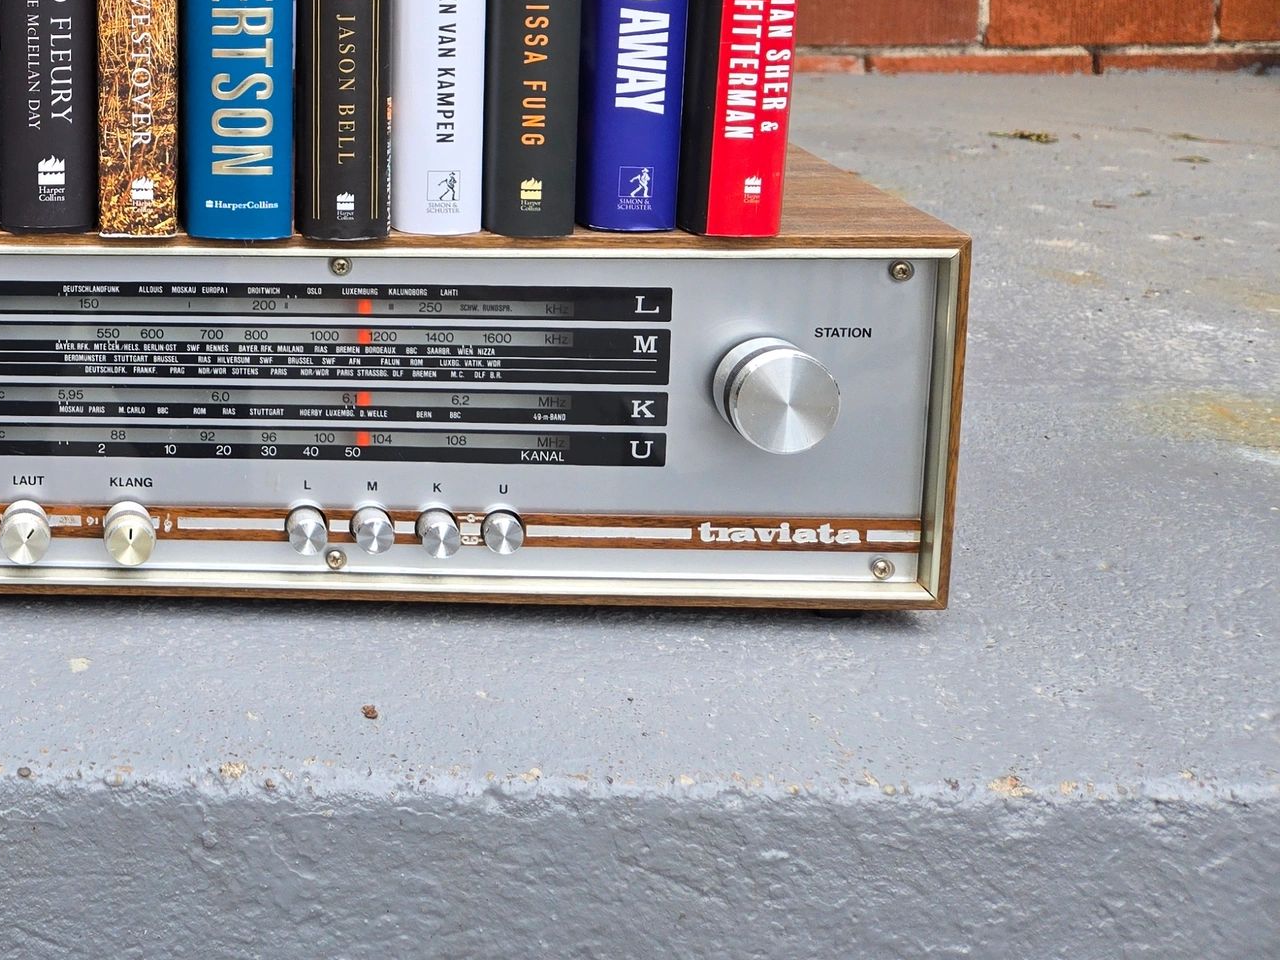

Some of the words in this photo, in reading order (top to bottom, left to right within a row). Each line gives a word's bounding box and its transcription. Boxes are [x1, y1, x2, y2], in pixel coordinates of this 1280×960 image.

[437, 23, 456, 58] VAN
[27, 14, 40, 92] McLELLAN
[336, 13, 356, 92] JASON
[615, 7, 671, 115] AWAY
[50, 17, 73, 124] FLEURY
[724, 0, 764, 139] FITTERMAN
[762, 49, 791, 111] SHER
[28, 99, 41, 130] DAY
[435, 67, 456, 144] KAMPEN
[520, 80, 547, 146] FUNG
[337, 104, 356, 165] BELL
[761, 121, 778, 132] &
[38, 185, 66, 196] Harper
[38, 193, 66, 202] Collins
[214, 200, 279, 211] HarperCollins
[247, 287, 281, 295] DROITWICH
[79, 299, 99, 309] 150
[252, 300, 276, 310] 200
[419, 302, 443, 312] 250
[634, 295, 660, 313] L
[96, 328, 120, 338] 550
[140, 329, 164, 339] 600
[200, 329, 224, 340] 700
[244, 330, 268, 340] 800
[310, 331, 339, 341] 1000
[369, 331, 397, 342] 1200
[425, 332, 454, 343] 1400
[483, 333, 512, 343] 1600
[813, 327, 873, 339] STATION
[632, 335, 658, 353] M
[114, 355, 149, 363] STUTTGART
[380, 358, 400, 366] FALUN
[58, 389, 84, 401] 5,95
[451, 395, 470, 406] 6,2
[538, 396, 566, 407] MHz
[249, 408, 284, 416] STUTTGART
[416, 411, 432, 419] BERN
[631, 400, 655, 418] K
[111, 430, 126, 440] 88
[200, 431, 216, 442] 92
[261, 432, 277, 442] 96
[314, 433, 335, 443] 100
[372, 434, 393, 444] 104
[446, 435, 467, 446] 108
[537, 437, 565, 448] MHz
[164, 444, 177, 455] 10
[216, 445, 232, 456] 20
[261, 446, 277, 456] 30
[303, 446, 319, 457] 40
[344, 447, 361, 458] 50
[520, 450, 565, 462] KANAL
[629, 441, 654, 459] U
[13, 475, 45, 487] LAUT
[109, 477, 153, 488] KLANG
[303, 480, 311, 490] L
[367, 481, 378, 491] M
[433, 482, 442, 493] K
[499, 484, 508, 495] U
[697, 522, 862, 544] traviata
